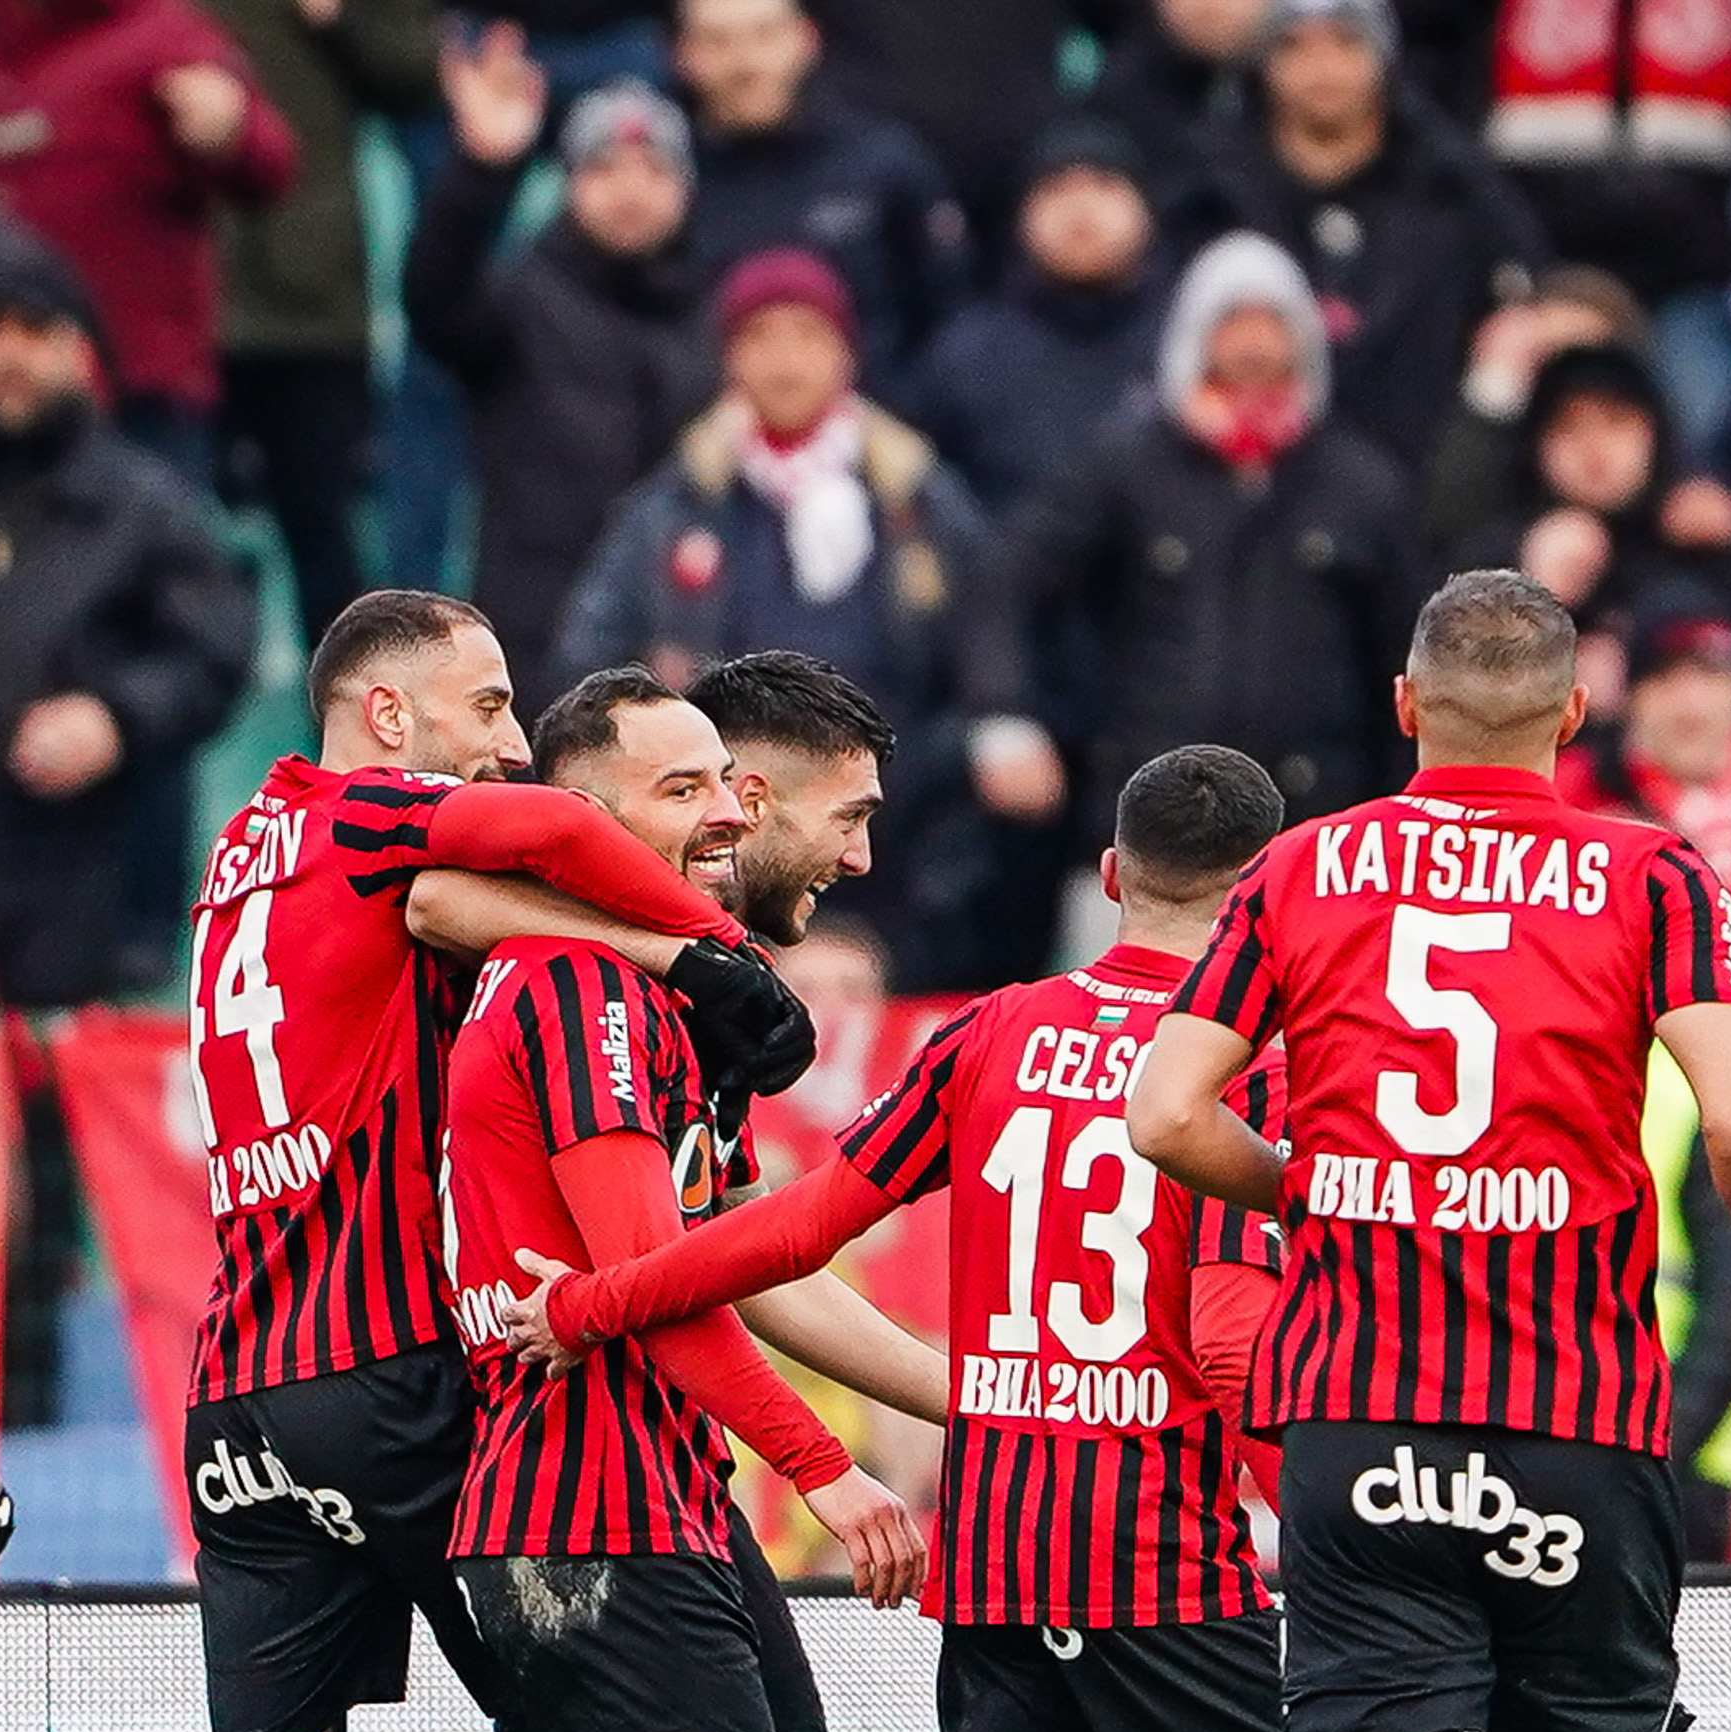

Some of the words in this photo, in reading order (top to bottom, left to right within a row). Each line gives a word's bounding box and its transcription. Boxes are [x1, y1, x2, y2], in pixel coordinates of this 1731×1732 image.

[1314, 820, 1610, 917] KATSIKAS
[598, 1001, 636, 1103] Malizia
[1375, 903, 1512, 1156] 5
[232, 1123, 331, 1206] 2000
[1431, 1165, 1569, 1232] 2000
[980, 1106, 1159, 1363] 13
[1044, 1362, 1169, 1428] 2000
